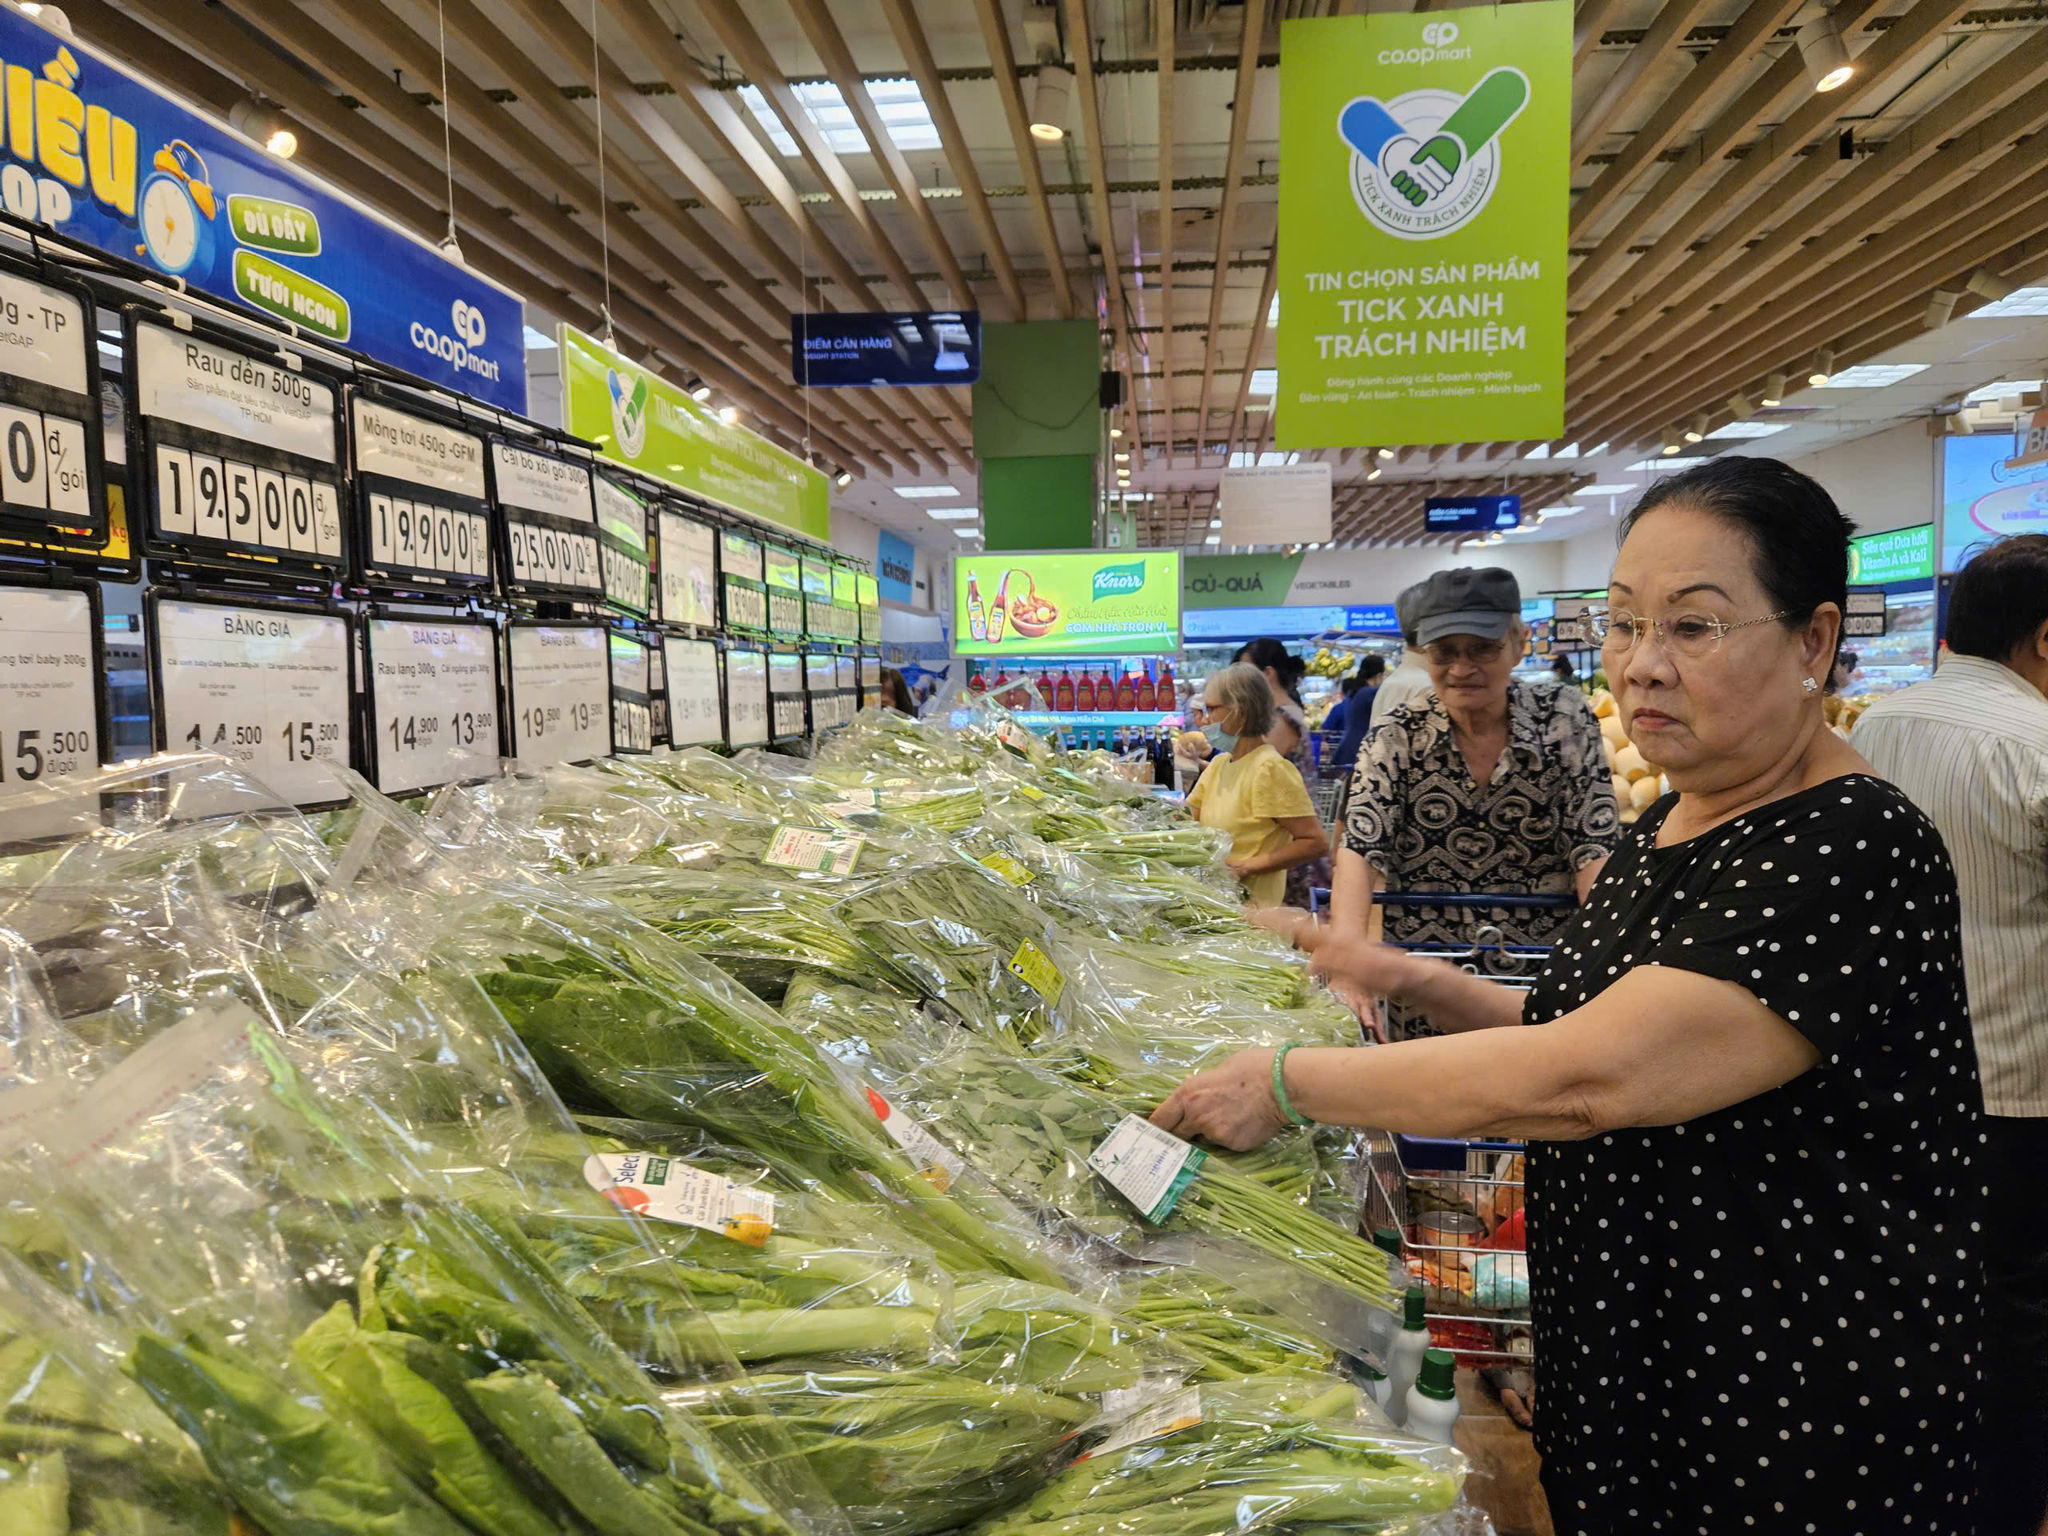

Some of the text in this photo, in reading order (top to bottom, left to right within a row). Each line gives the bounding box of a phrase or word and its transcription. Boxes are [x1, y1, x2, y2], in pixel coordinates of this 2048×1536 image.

[0, 45, 137, 217] IỀU
[1362, 167, 1489, 228] TICK XANH TRÁCH NHIỆM
[1305, 255, 1540, 292] TIN CHỌN SẢN PHẨM
[40, 306, 66, 333] TP
[293, 291, 337, 331] NGON
[1337, 293, 1503, 324] TICK XANH
[1315, 322, 1526, 359] TRÁCH NHIỆM
[185, 343, 312, 408] Rau dền 500g
[1357, 376, 1383, 387] hành
[1386, 374, 1412, 387] cùng
[1437, 371, 1472, 383] Doanh
[1408, 386, 1438, 398] Trách
[1484, 383, 1511, 395] Minh
[1514, 382, 1542, 395] bạch
[419, 434, 446, 459] 450g
[169, 460, 309, 536] 19.500
[378, 504, 469, 561] 19.900
[1093, 571, 1144, 590] Knorr
[1295, 579, 1351, 591] VEGETABLES
[36, 653, 61, 667] baby
[378, 662, 396, 675] Rau
[398, 663, 416, 677] lang
